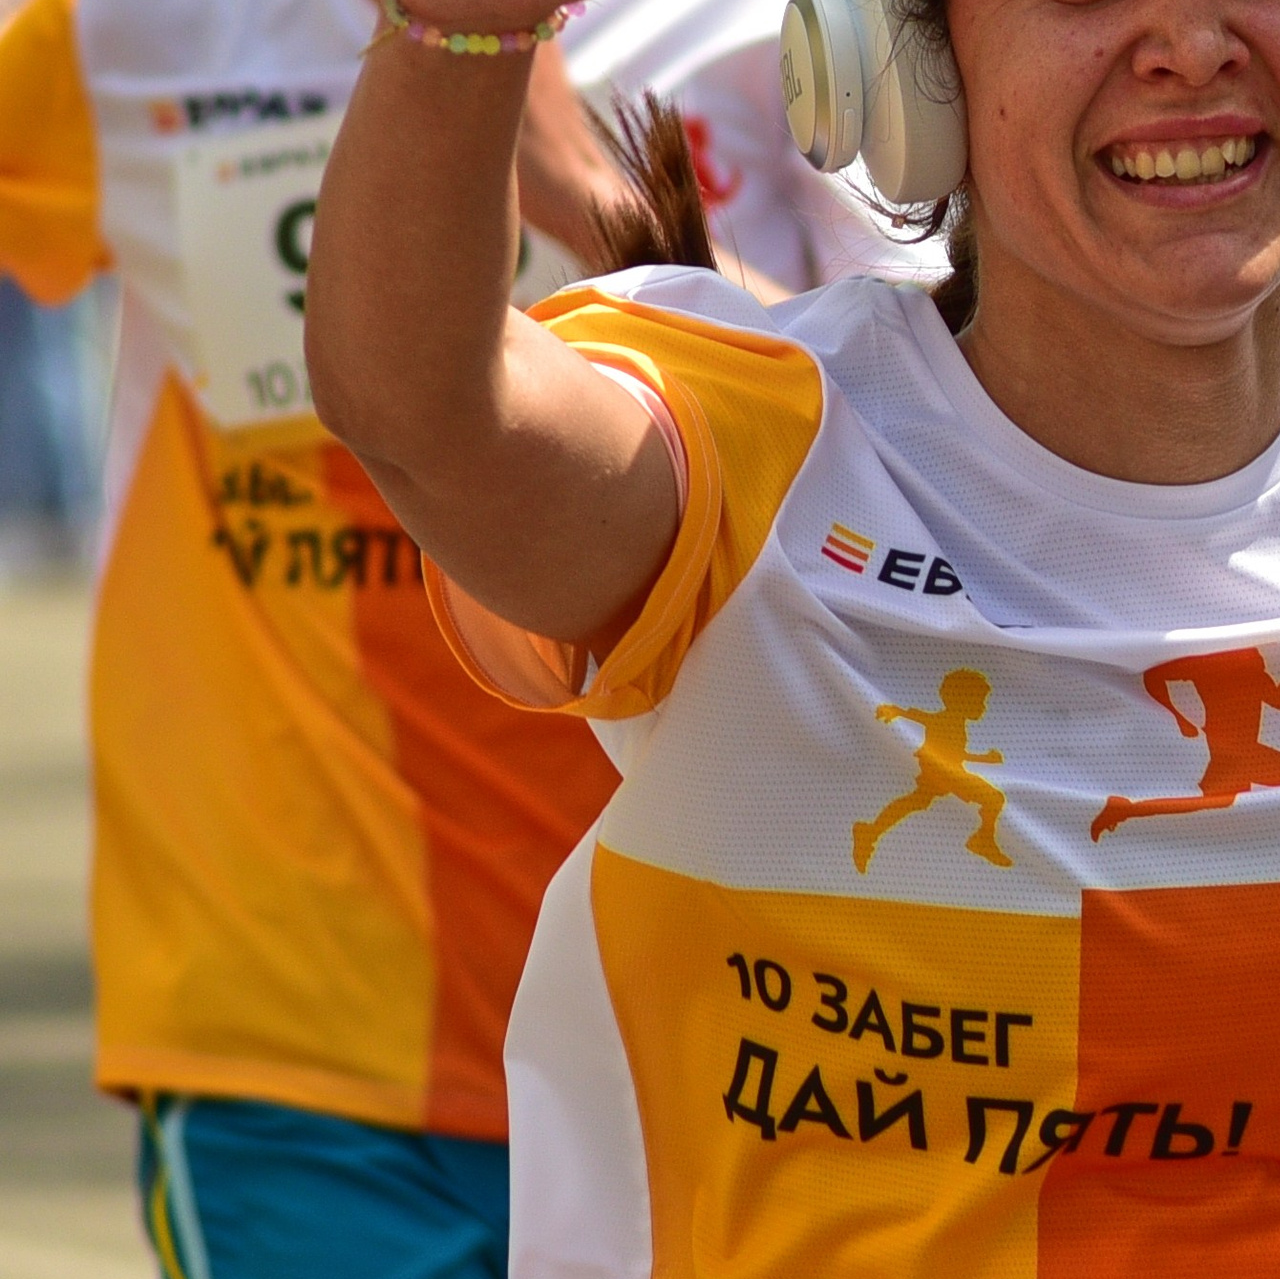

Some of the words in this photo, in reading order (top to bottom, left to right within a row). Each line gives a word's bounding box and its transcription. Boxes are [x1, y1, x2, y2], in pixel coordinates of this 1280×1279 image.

[726, 951, 792, 1012] 10
[811, 972, 1033, 1068] ЗАБЕГ
[722, 1037, 928, 1152] ДАЙ
[965, 1096, 1253, 1175] ПЯТЬ!
